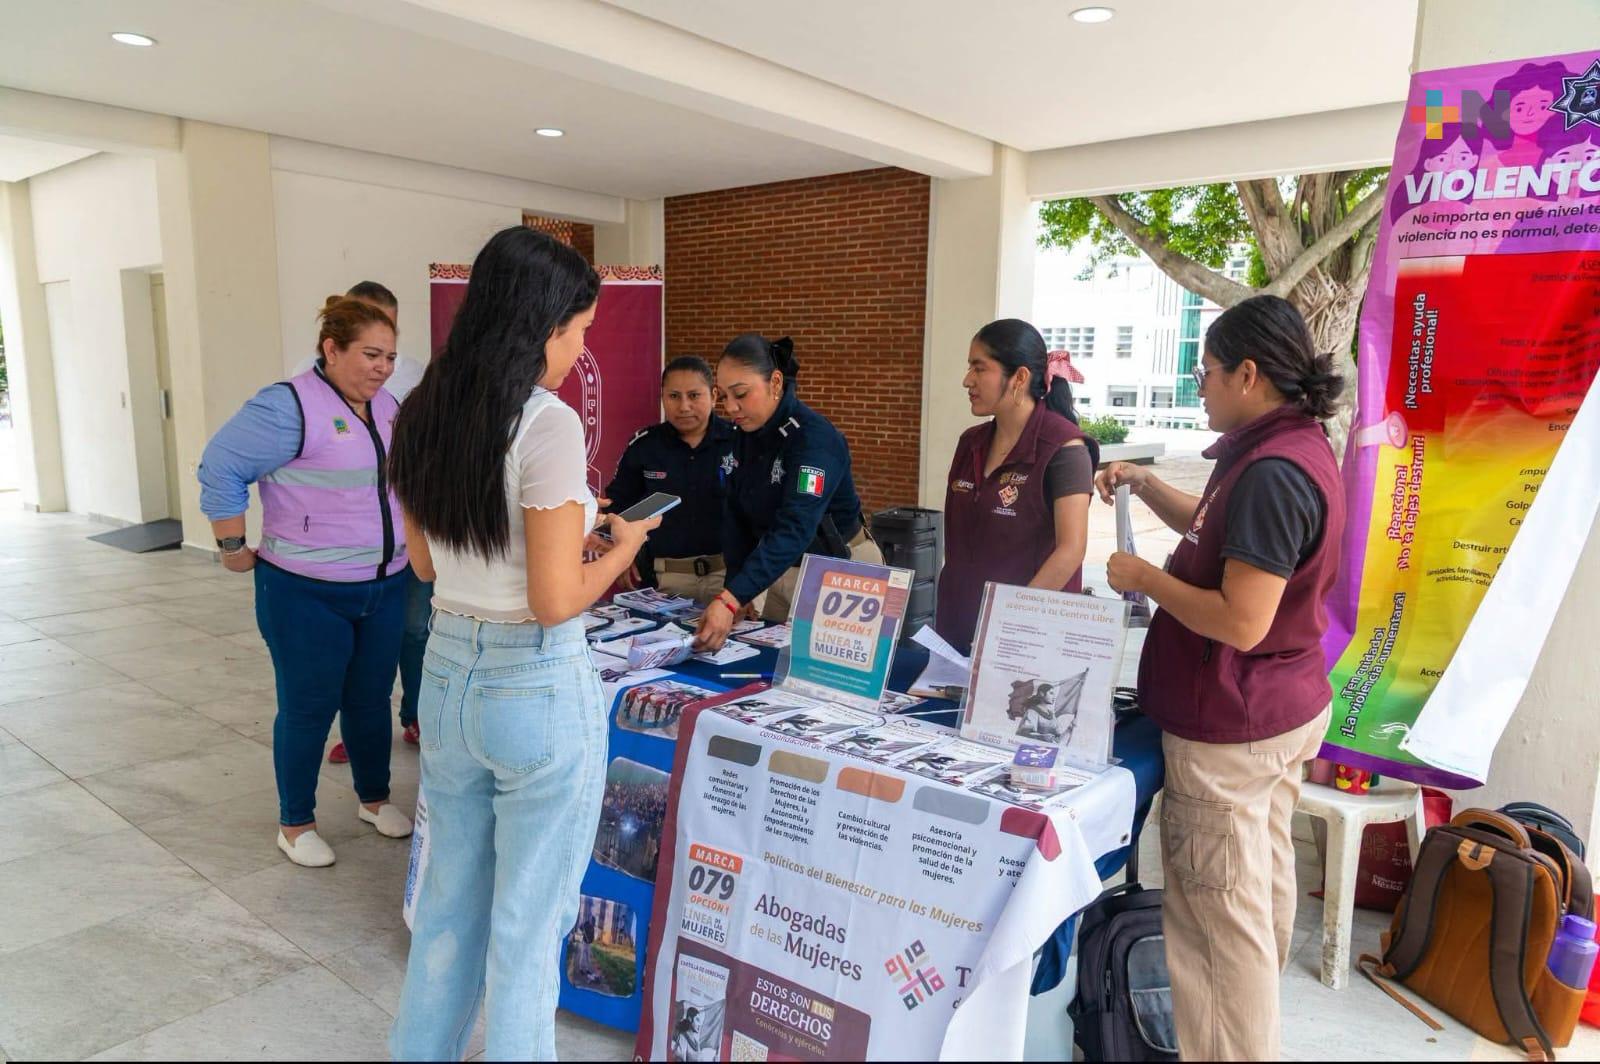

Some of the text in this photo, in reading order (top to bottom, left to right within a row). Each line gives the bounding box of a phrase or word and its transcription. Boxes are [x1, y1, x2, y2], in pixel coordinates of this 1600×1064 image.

[1412, 213, 1430, 225] No
[1432, 211, 1489, 226] importa
[1492, 211, 1511, 221] en
[1515, 206, 1544, 223] qué
[1547, 204, 1585, 218] nivel
[1398, 223, 1600, 243] violencia no es normal, dete
[1405, 293, 1427, 410] ¡Necesitas ayuda
[1420, 309, 1439, 394] profesional!
[1407, 435, 1425, 493] destruir!
[1519, 467, 1549, 477] Empu
[1524, 483, 1540, 493] Pel
[1387, 465, 1407, 541] ¡Reacciona!
[1403, 495, 1419, 531] dejes
[1505, 500, 1531, 511] Golp
[1509, 517, 1524, 526] Ca
[1452, 541, 1491, 554] Destruir
[831, 575, 881, 593] MARCA
[1475, 578, 1491, 588] celu
[822, 591, 880, 623] 079
[815, 642, 868, 663] MUJERES
[1340, 627, 1386, 699] ¡Ten cuidado!
[1339, 591, 1406, 739] ¡La violencia aumentará!
[1420, 667, 1444, 679] Acec
[708, 776, 745, 790] comunitarias
[722, 768, 738, 779] Redes
[712, 785, 736, 798] fomento
[770, 776, 820, 797] Promoción de los
[770, 786, 798, 800] Derechos
[807, 797, 816, 806] las
[703, 791, 747, 810] liderazgo de las
[711, 805, 736, 817] mujeres.
[774, 798, 808, 813] Mujeres, la
[763, 814, 814, 836] Empoderamiento
[771, 807, 809, 825] Autonomía y
[838, 811, 891, 832] Cambio cultural
[773, 827, 782, 836] las
[782, 831, 809, 845] mujeres.
[836, 821, 889, 842] y prevención de
[838, 831, 884, 852] las violencias.
[929, 824, 962, 841] Asesoría
[912, 831, 977, 858] psicoemocional y
[912, 844, 973, 866] promoción de la
[695, 848, 736, 869] MARCA
[918, 856, 963, 875] salud de las
[688, 865, 735, 900] 079
[922, 868, 955, 885] mujeres.
[998, 867, 1022, 878] y ate
[763, 850, 984, 933] Políticas del Bienestar para las Mujeres
[753, 893, 847, 944] Abogadas
[681, 918, 725, 943] MUJERES
[750, 922, 863, 982] de las Mujeres
[955, 966, 972, 988] T
[756, 976, 833, 1019] ESTOS SON TUS
[750, 991, 832, 1041] DERECHOS
